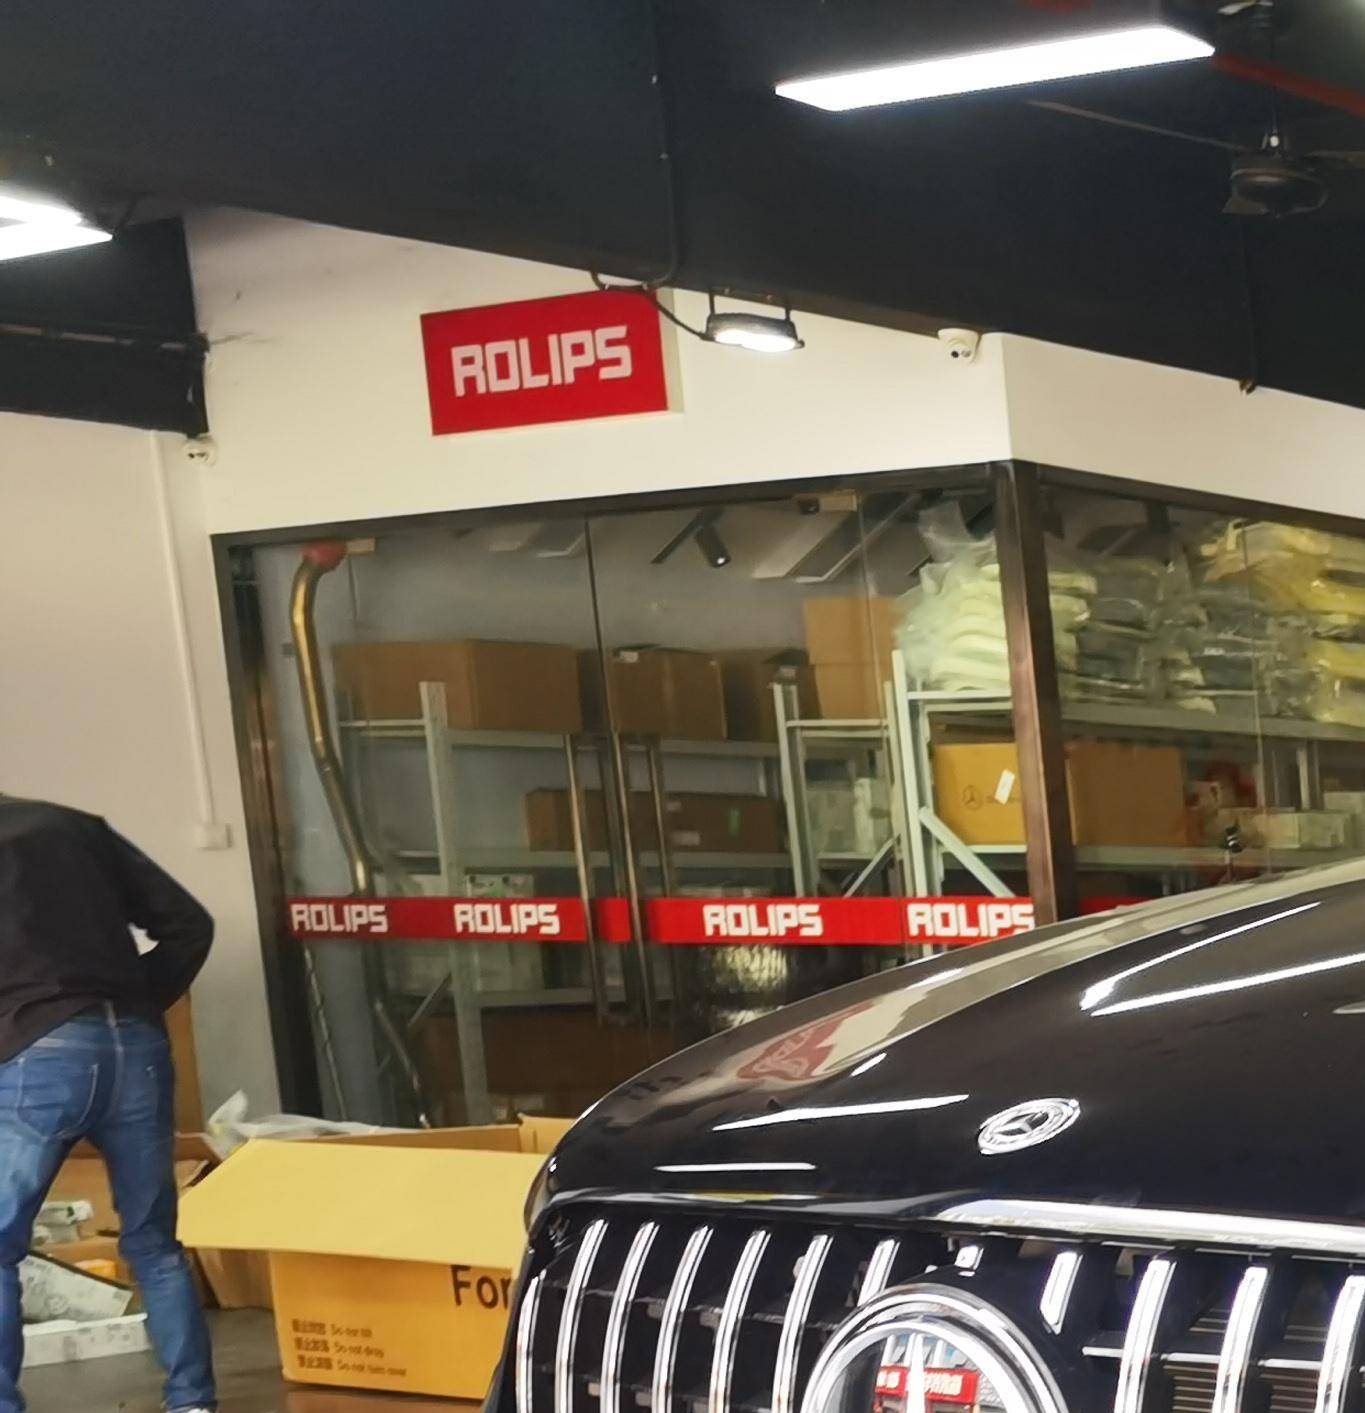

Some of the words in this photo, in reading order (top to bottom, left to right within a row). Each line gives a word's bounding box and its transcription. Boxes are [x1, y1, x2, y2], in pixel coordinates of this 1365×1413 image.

[451, 325, 632, 397] ROLIPS
[291, 903, 388, 933] ROLIPS
[454, 903, 560, 935] ROLIPS
[703, 903, 823, 937] ROLIPS
[907, 903, 1034, 937] ROLIPS
